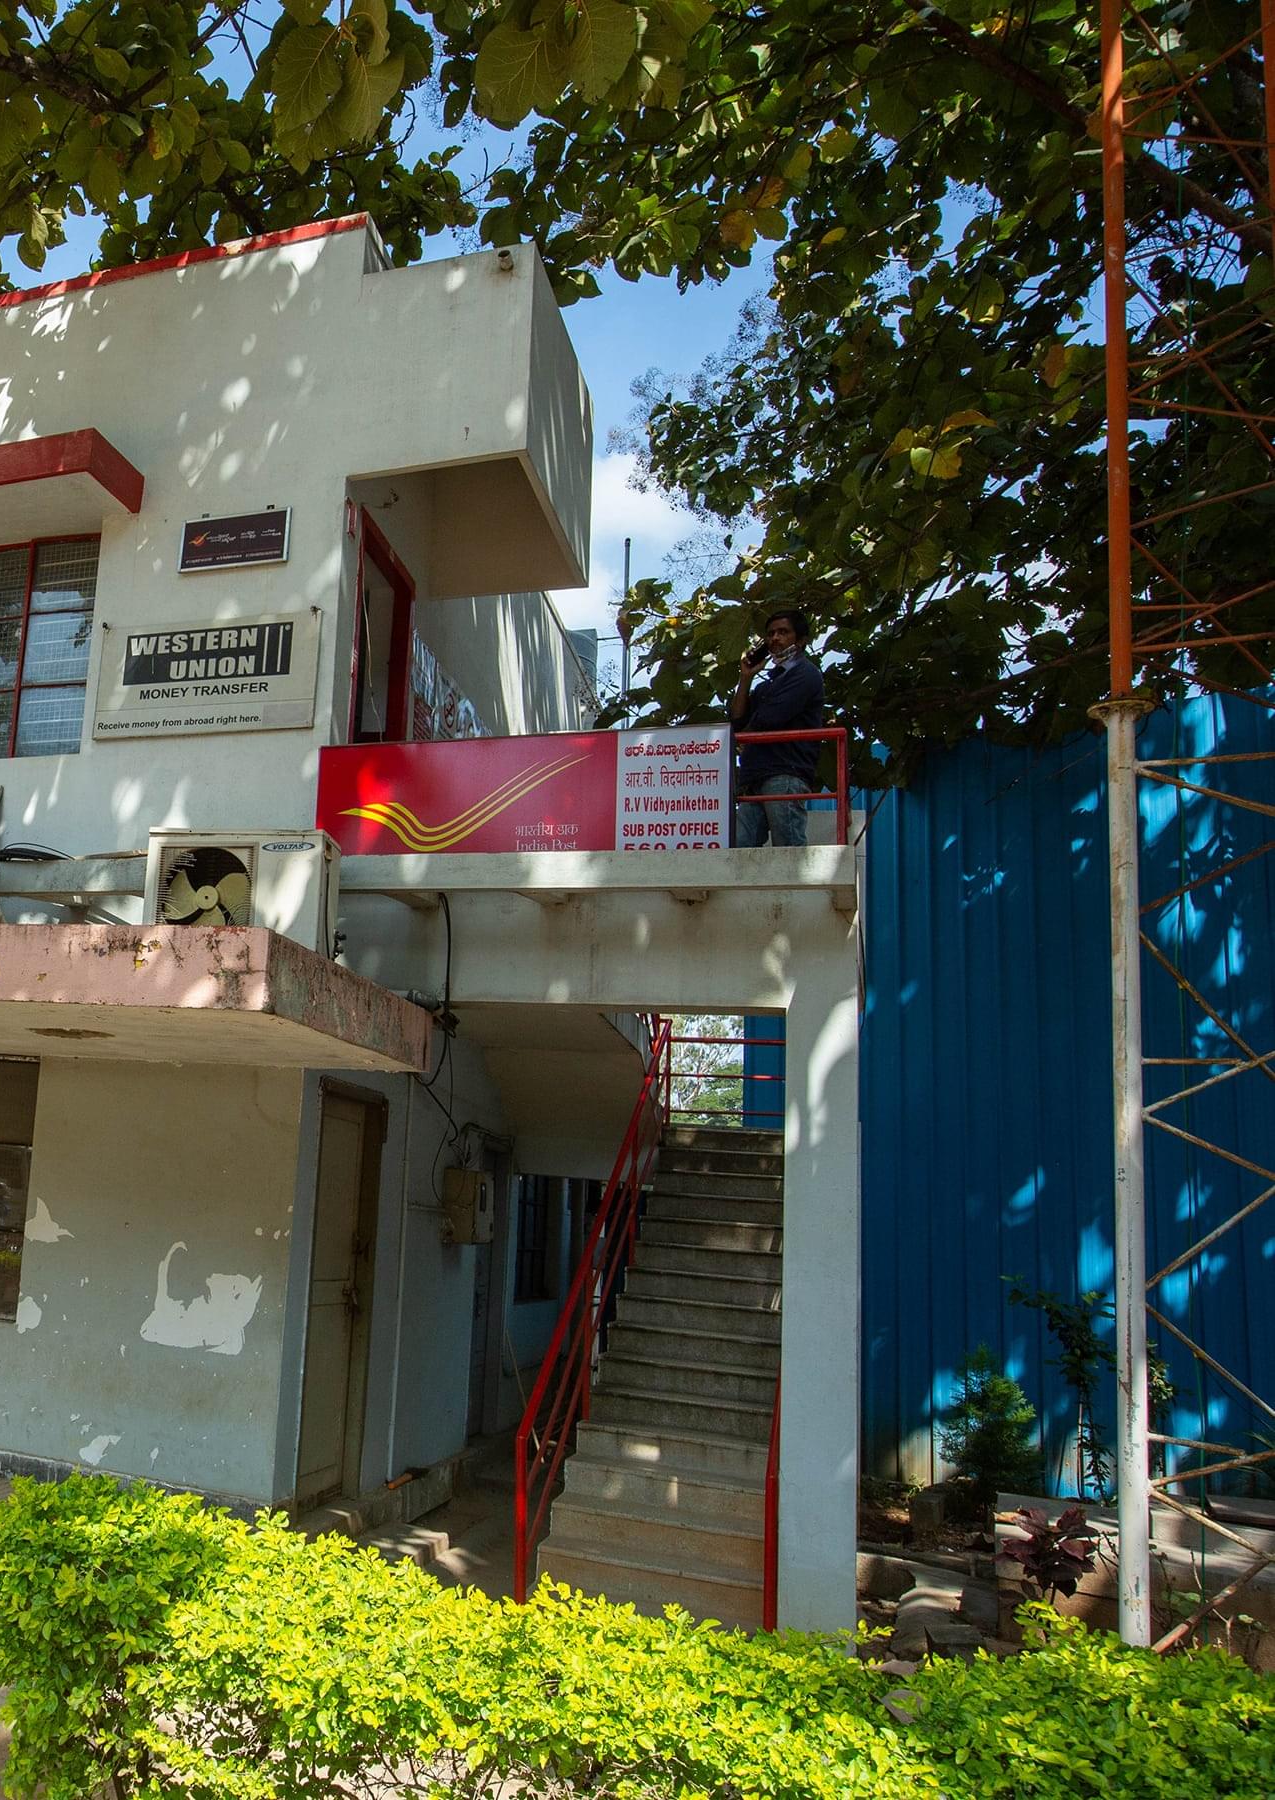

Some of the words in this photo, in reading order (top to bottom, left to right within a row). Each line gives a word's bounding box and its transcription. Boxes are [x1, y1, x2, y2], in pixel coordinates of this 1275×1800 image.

[130, 627, 258, 657] WESTERN
[169, 655, 256, 680] UNION
[139, 686, 189, 701] MONEY
[192, 682, 269, 697] TRANSFER
[97, 721, 130, 731] Receive
[131, 721, 161, 730] money
[162, 717, 182, 727] from
[183, 715, 215, 727] abroad
[216, 714, 238, 726] right
[239, 714, 262, 724] here.
[624, 797, 641, 812] R.V
[643, 795, 719, 815] Vidhyanikethan
[515, 821, 554, 837] भारतीय
[556, 823, 580, 836] डाक
[623, 824, 645, 837] SUB
[647, 823, 677, 837] POST
[679, 822, 719, 836] OFFICE
[516, 839, 548, 851] India
[552, 839, 578, 850] Post
